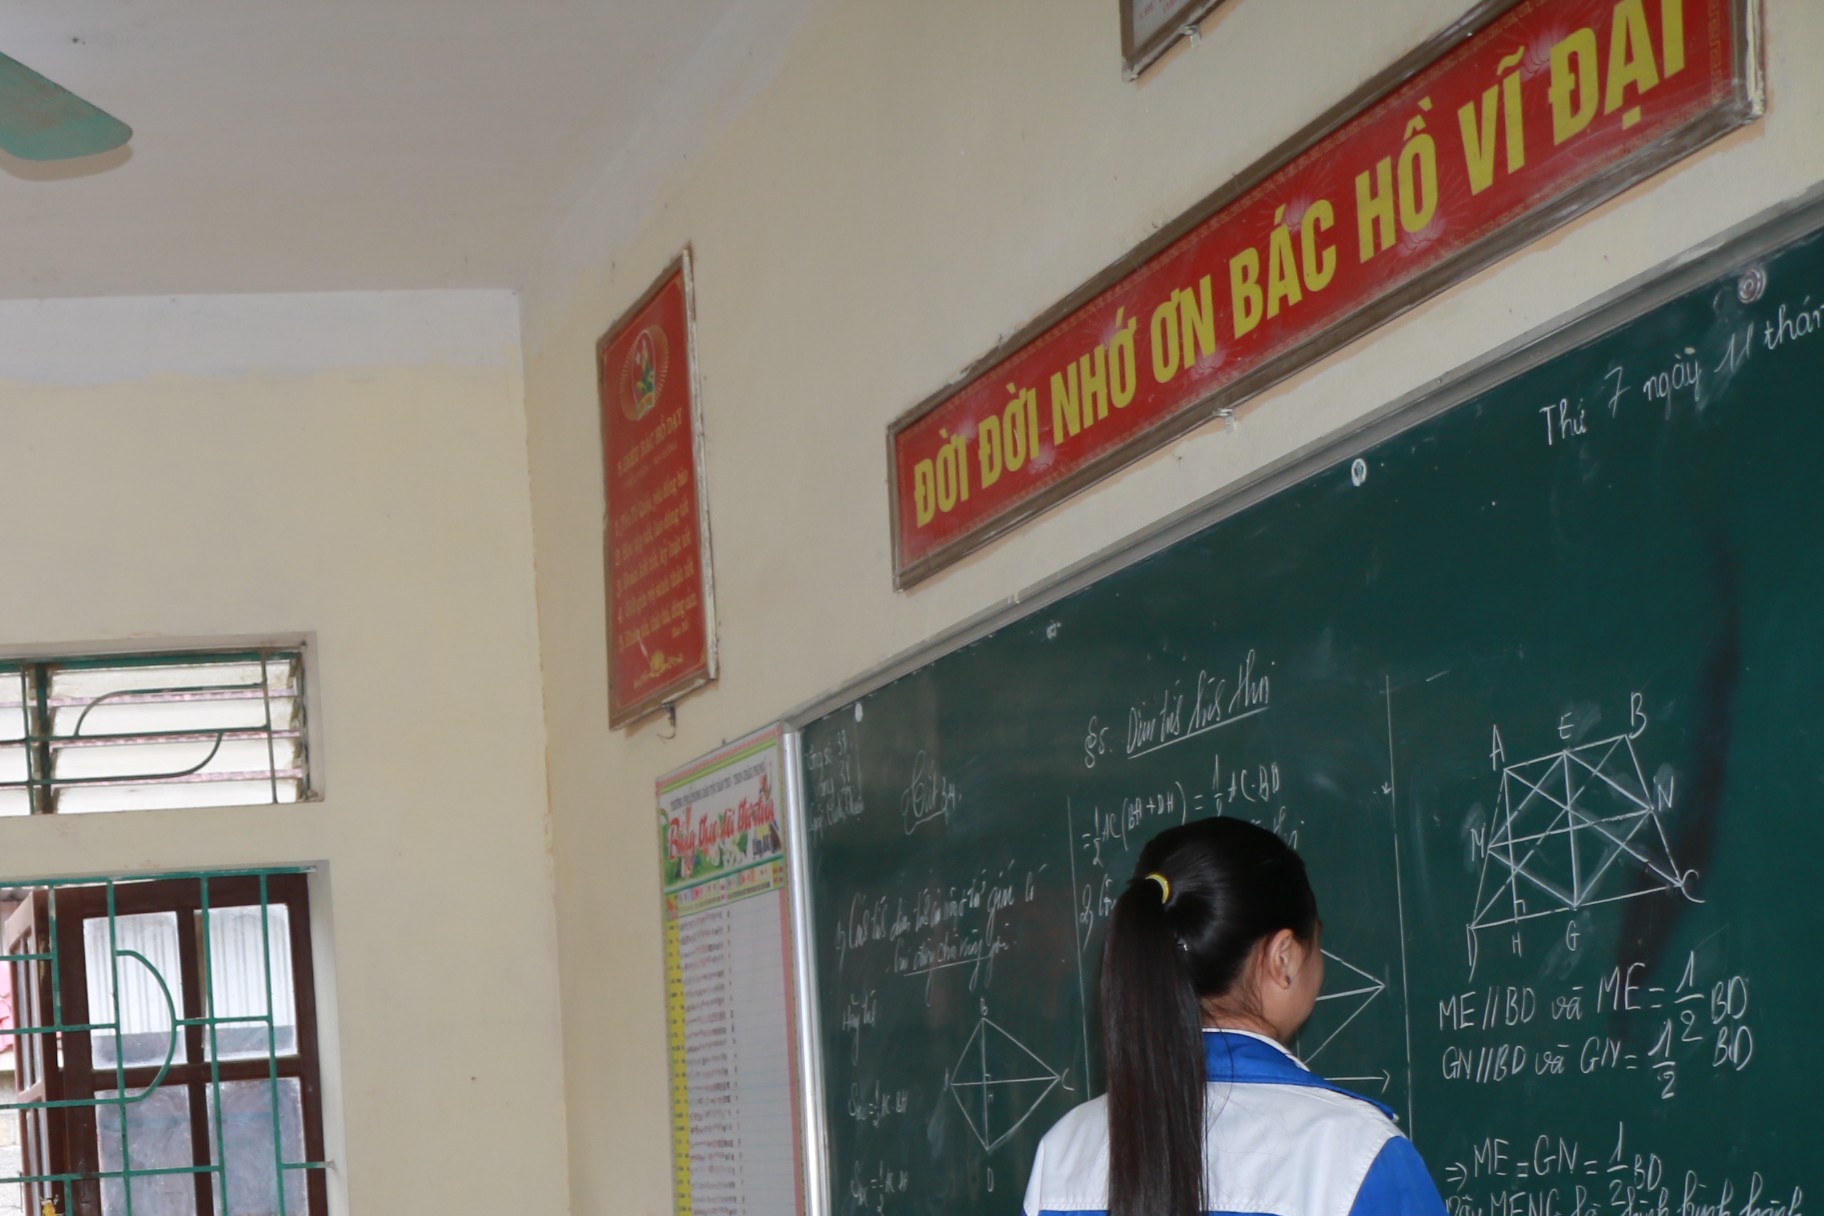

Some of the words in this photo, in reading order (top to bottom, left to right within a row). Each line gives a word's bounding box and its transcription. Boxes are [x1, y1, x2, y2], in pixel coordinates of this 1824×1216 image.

[913, 424, 972, 529] ĐỜI
[978, 380, 1041, 491] ĐỜI
[1050, 303, 1137, 443] NHỚ
[1150, 276, 1216, 384] ƠN
[1230, 198, 1338, 338] BÁC
[1354, 96, 1439, 264] HỒ
[1457, 45, 1526, 196] VĨ
[1547, 0, 1686, 147] ĐẠI
[1603, 365, 1632, 419] 7
[1643, 353, 1703, 421] ngày
